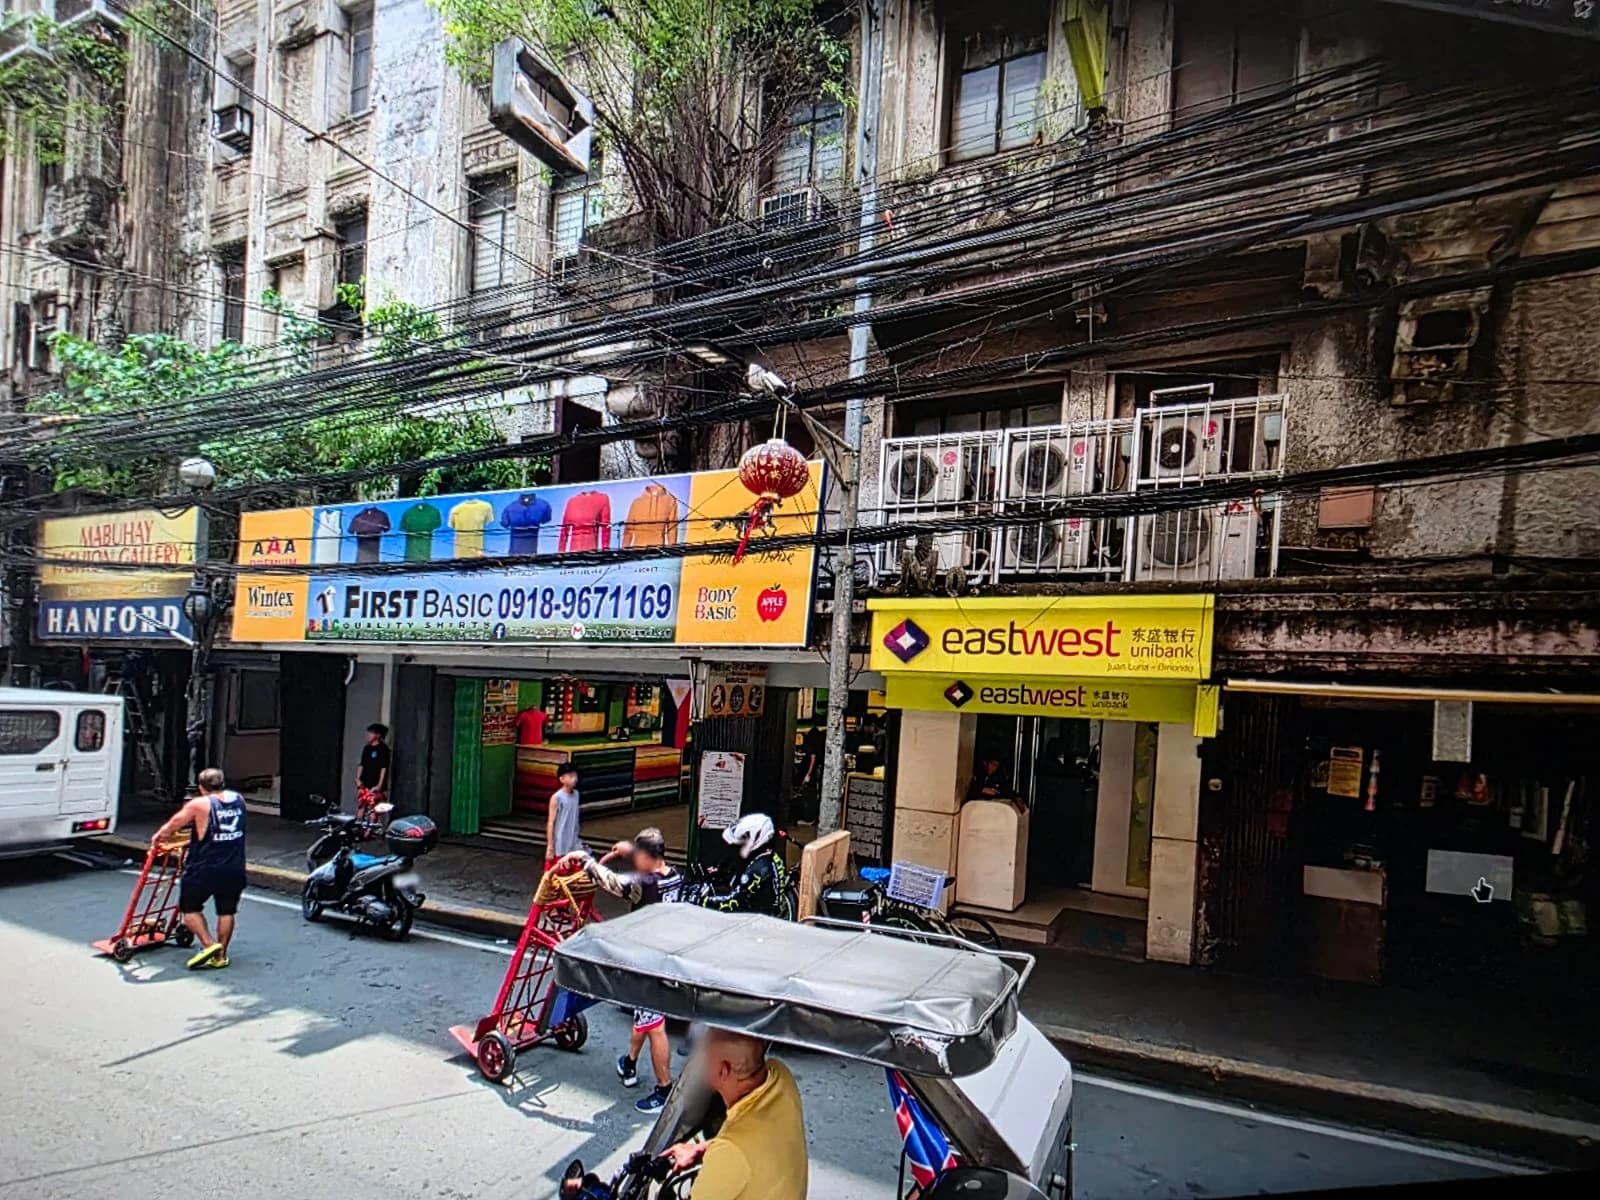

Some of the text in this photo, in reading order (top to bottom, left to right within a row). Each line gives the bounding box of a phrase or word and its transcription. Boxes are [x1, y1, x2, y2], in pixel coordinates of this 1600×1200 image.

[80, 520, 154, 547] MABUHAY
[248, 585, 294, 608] Wintex
[344, 584, 672, 619] FIRST BASIC 0918-9671169
[697, 586, 738, 603] BODY
[761, 597, 785, 607] APPLE
[48, 605, 180, 633] HANFORD
[695, 604, 737, 620] BASIC
[424, 621, 490, 630] SHIRTS
[942, 619, 1122, 657] eastwest
[1130, 643, 1194, 659] unibank
[980, 683, 1088, 708] eastwest
